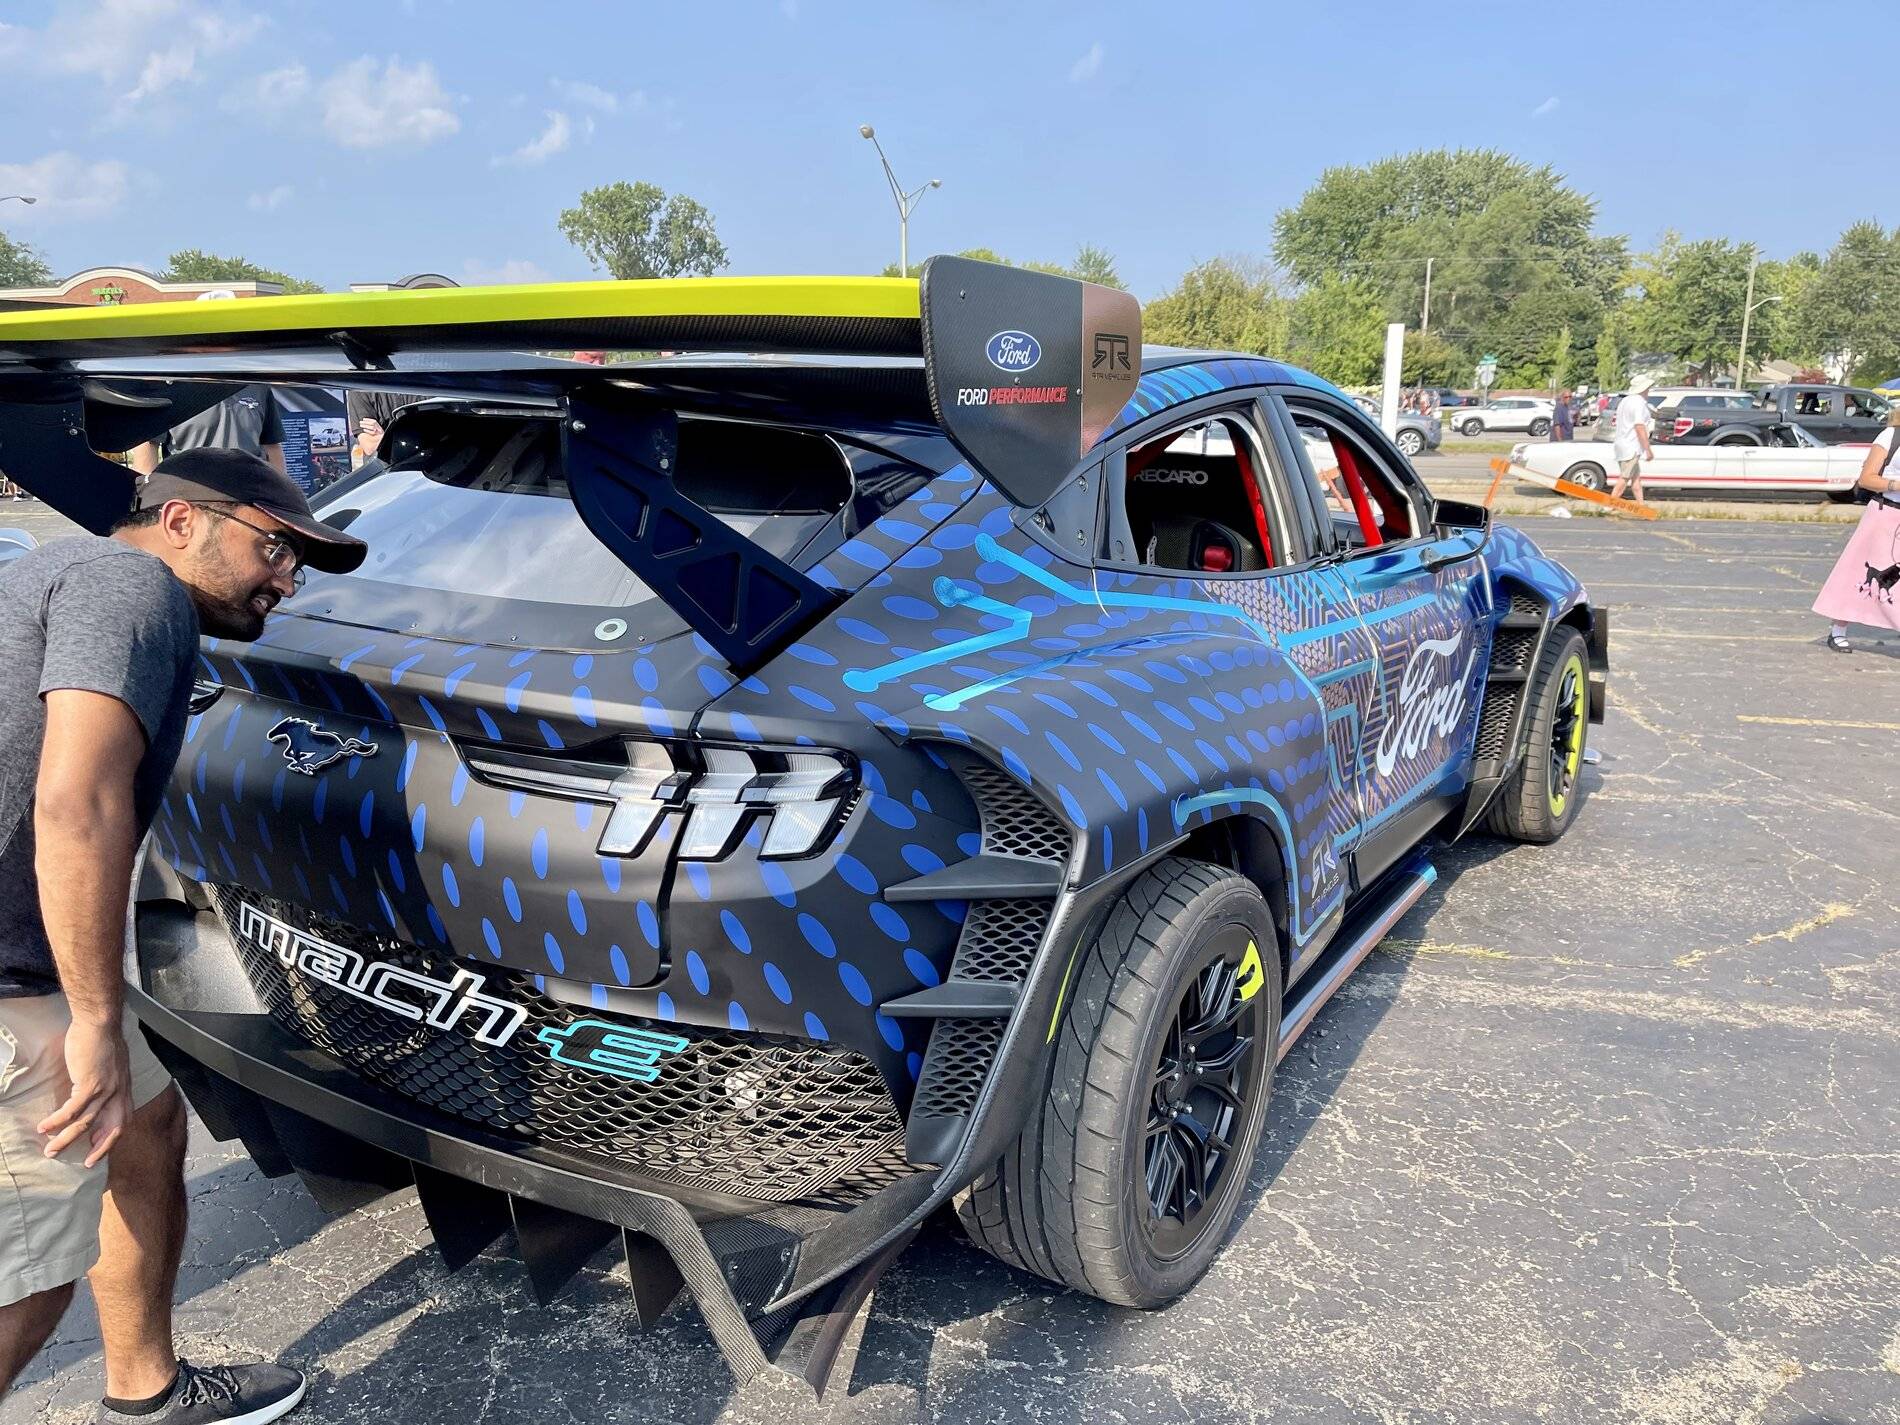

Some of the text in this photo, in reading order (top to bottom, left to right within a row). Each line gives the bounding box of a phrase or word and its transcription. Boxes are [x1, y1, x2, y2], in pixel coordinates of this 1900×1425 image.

[998, 335, 1031, 365] Ford
[958, 387, 1068, 406] FORD PERFORMANCE
[1377, 630, 1477, 777] Ford
[240, 901, 528, 1048] mach
